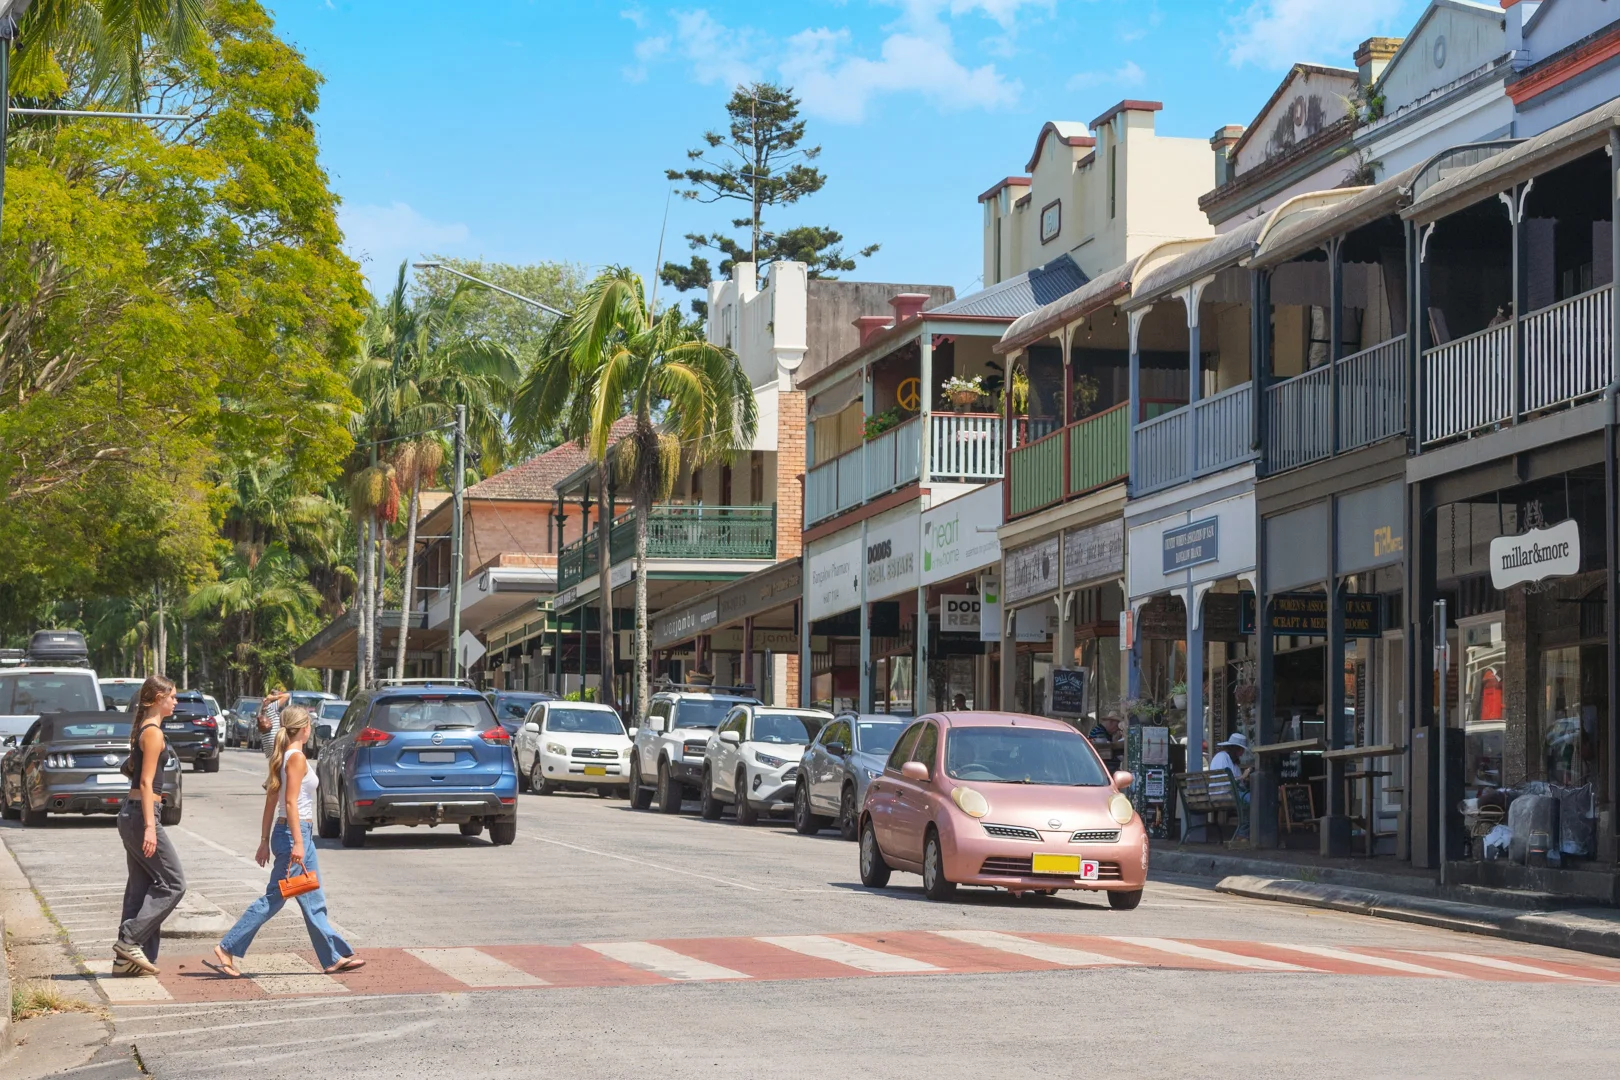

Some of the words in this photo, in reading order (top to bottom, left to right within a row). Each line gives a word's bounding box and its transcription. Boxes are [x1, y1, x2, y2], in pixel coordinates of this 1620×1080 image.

[931, 512, 959, 549] heart
[1501, 541, 1569, 570] millar&more
[947, 600, 980, 613] DOD
[947, 613, 980, 626] REA
[1083, 863, 1095, 877] P
